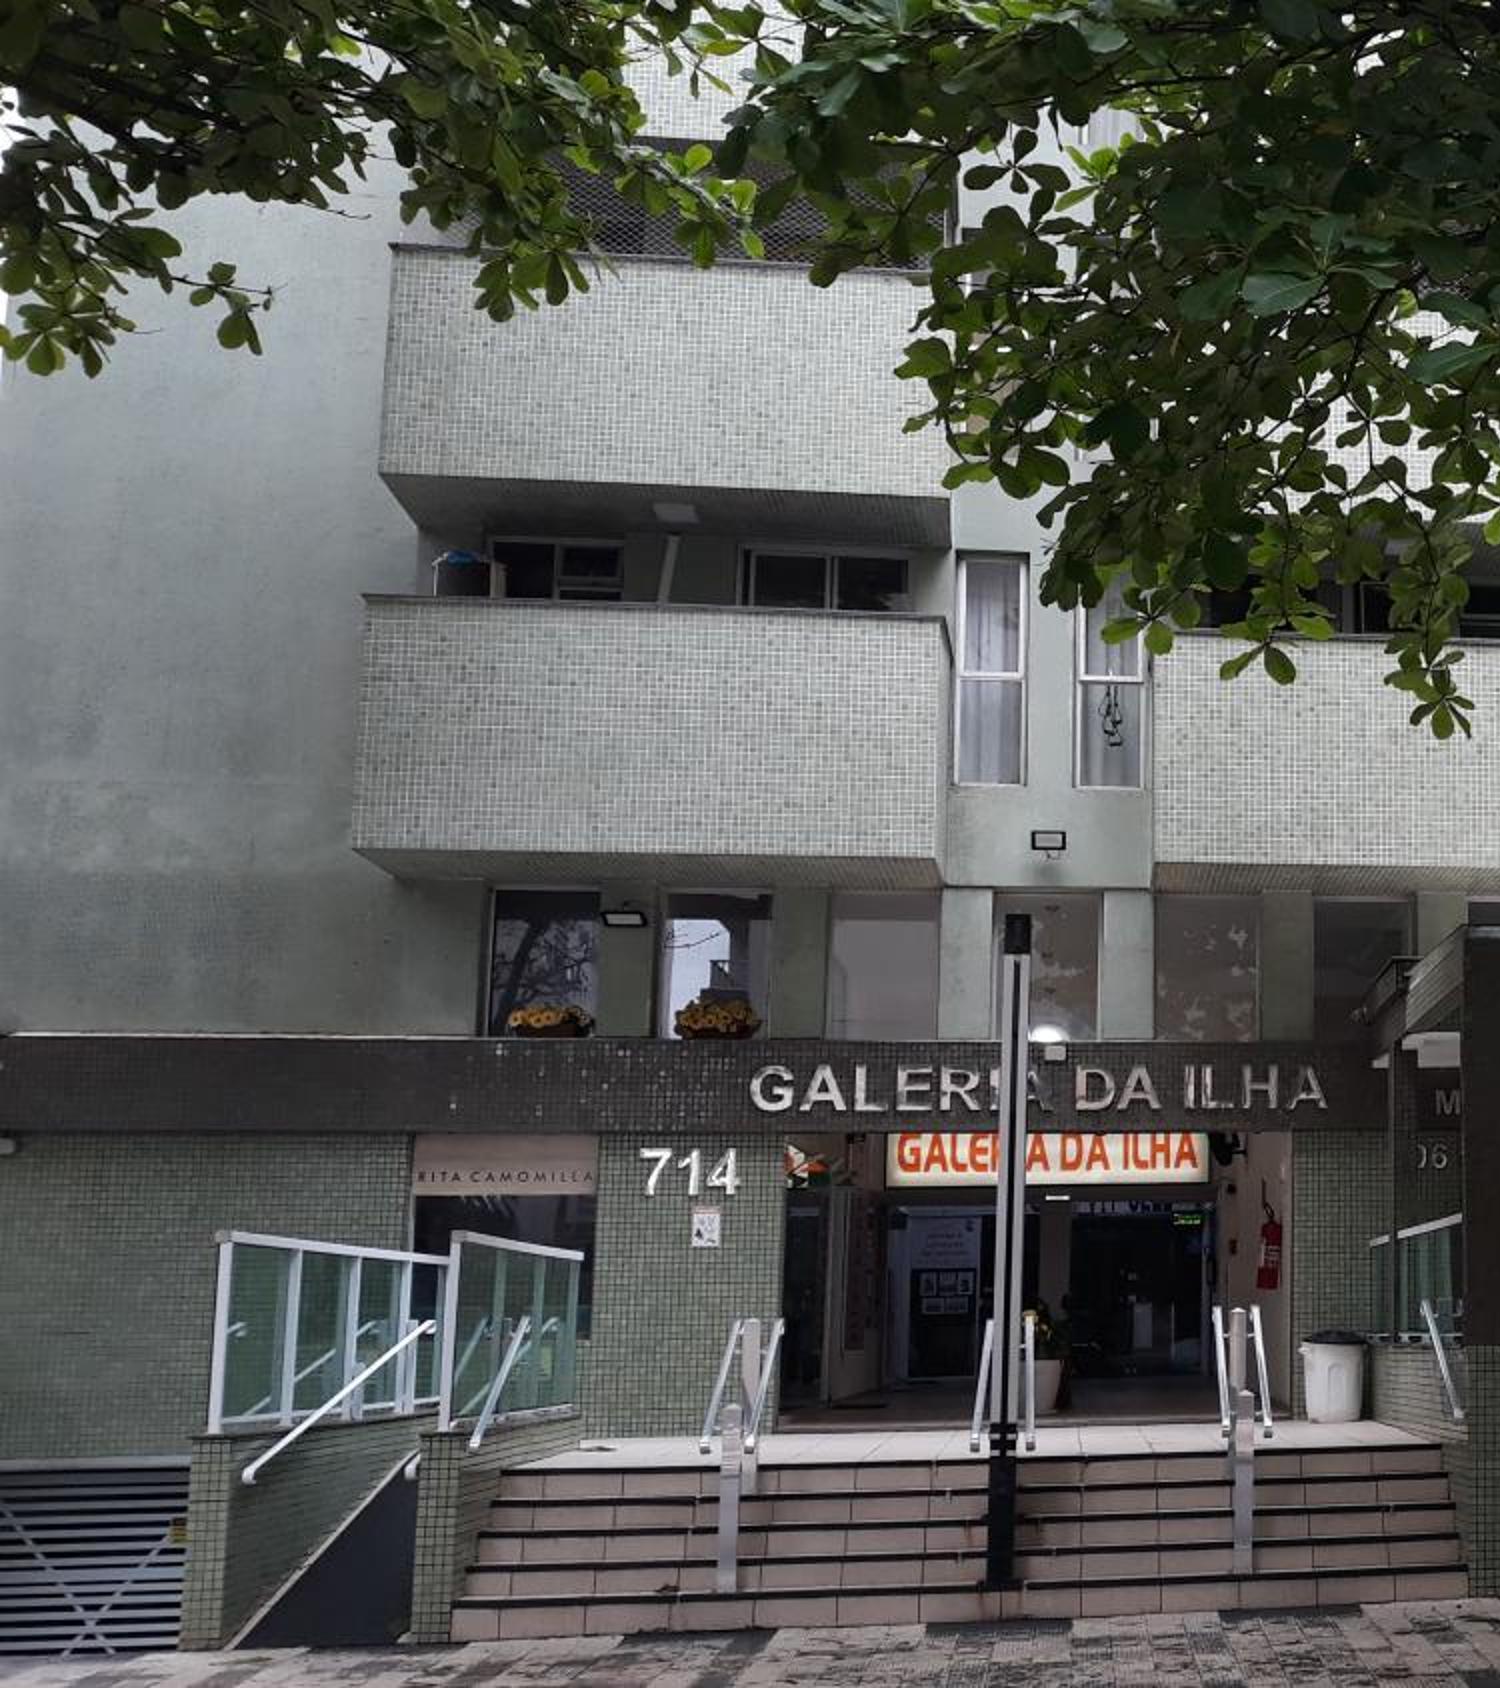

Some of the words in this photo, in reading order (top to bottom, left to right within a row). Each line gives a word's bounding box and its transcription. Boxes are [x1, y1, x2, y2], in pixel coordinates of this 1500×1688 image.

[750, 1063, 1054, 1111] GALERIA
[1076, 1063, 1161, 1111] DA
[1184, 1063, 1328, 1110] ILHA
[639, 1147, 740, 1195] 714
[897, 1133, 1051, 1173] GALEA
[1059, 1133, 1111, 1171] DA
[1122, 1132, 1198, 1170] ILHA
[417, 1171, 461, 1183] RITA
[469, 1171, 593, 1183] CAMOMILLA
